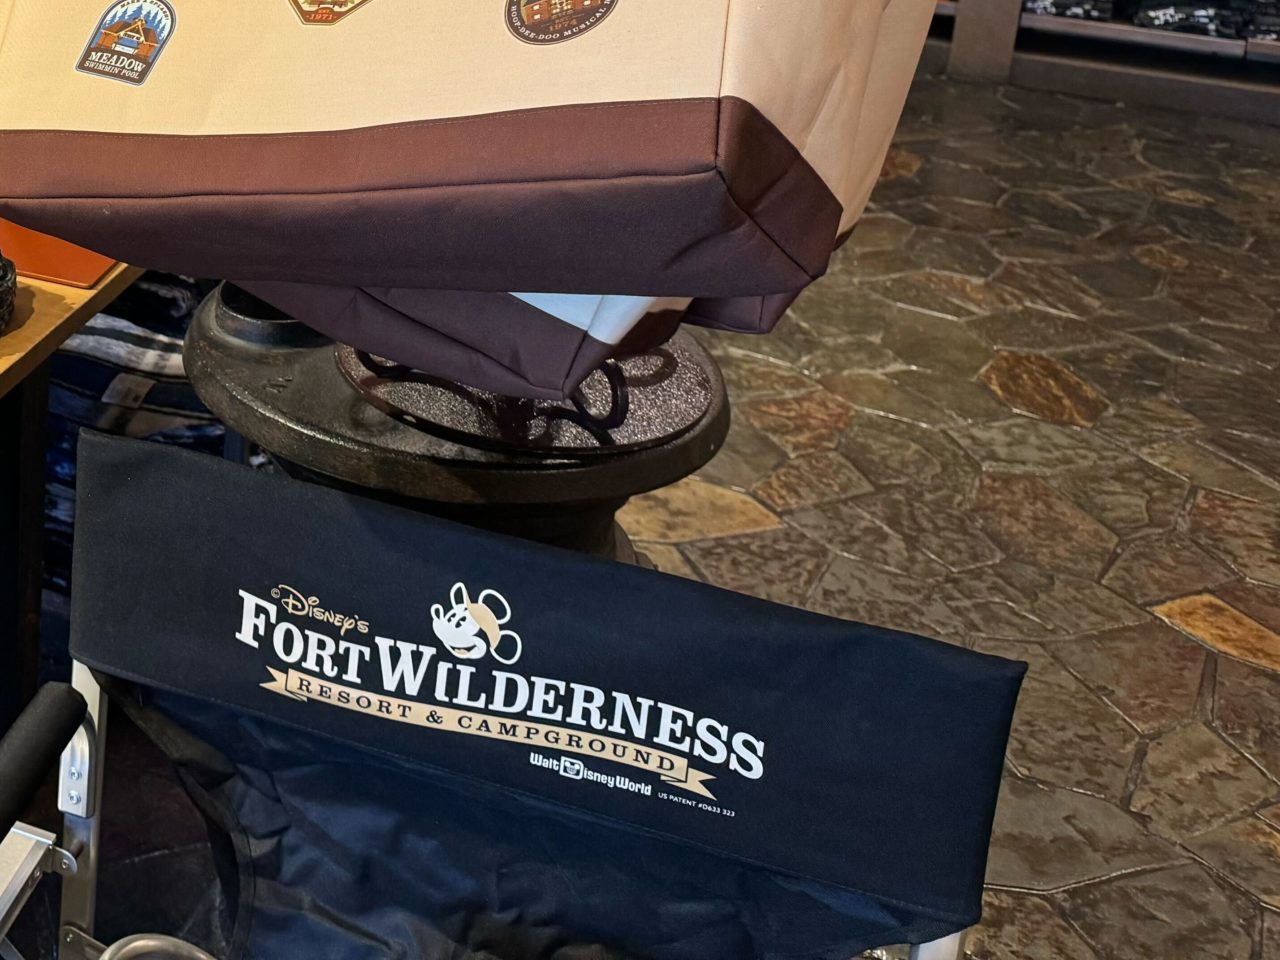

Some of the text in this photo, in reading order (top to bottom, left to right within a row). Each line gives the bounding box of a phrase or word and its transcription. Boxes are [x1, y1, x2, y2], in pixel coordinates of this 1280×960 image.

[510, 5, 560, 40] HOOP-DEE-DOO
[563, 7, 607, 37] MUSICAL
[83, 60, 140, 79] SWIMMIN' POOL
[88, 51, 147, 72] MEADOW
[278, 584, 370, 637] Disney's
[235, 588, 766, 780] FORT WILDERNESS
[296, 676, 676, 773] RESORT & CAMPGROUND
[529, 752, 653, 796] Walt Disney World
[657, 791, 669, 800] US
[669, 794, 697, 807] PATENT
[722, 808, 736, 817] 323
